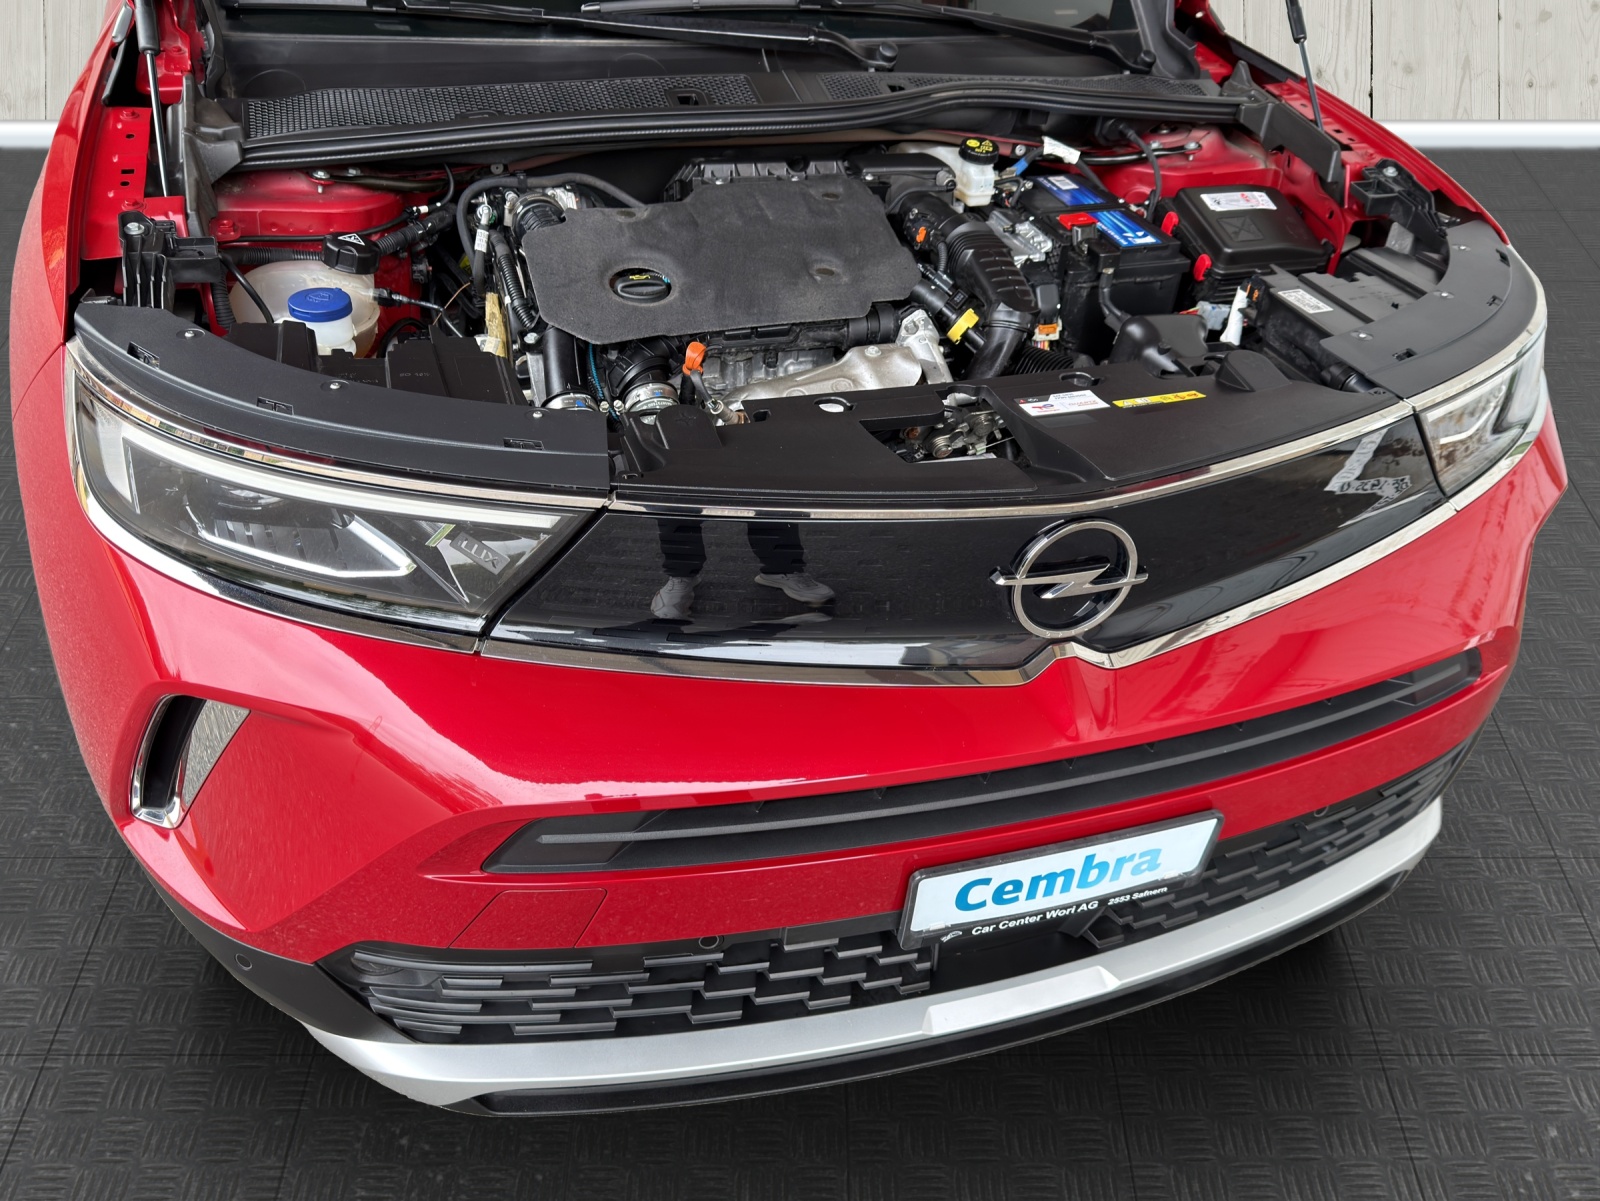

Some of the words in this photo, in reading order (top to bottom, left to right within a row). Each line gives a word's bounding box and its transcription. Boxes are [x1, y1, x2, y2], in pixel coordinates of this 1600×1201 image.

[954, 848, 1162, 912] Cembra
[1107, 894, 1131, 905] 2553
[971, 924, 996, 936] Car
[998, 913, 1043, 930] Center
[1077, 900, 1099, 913] AG
